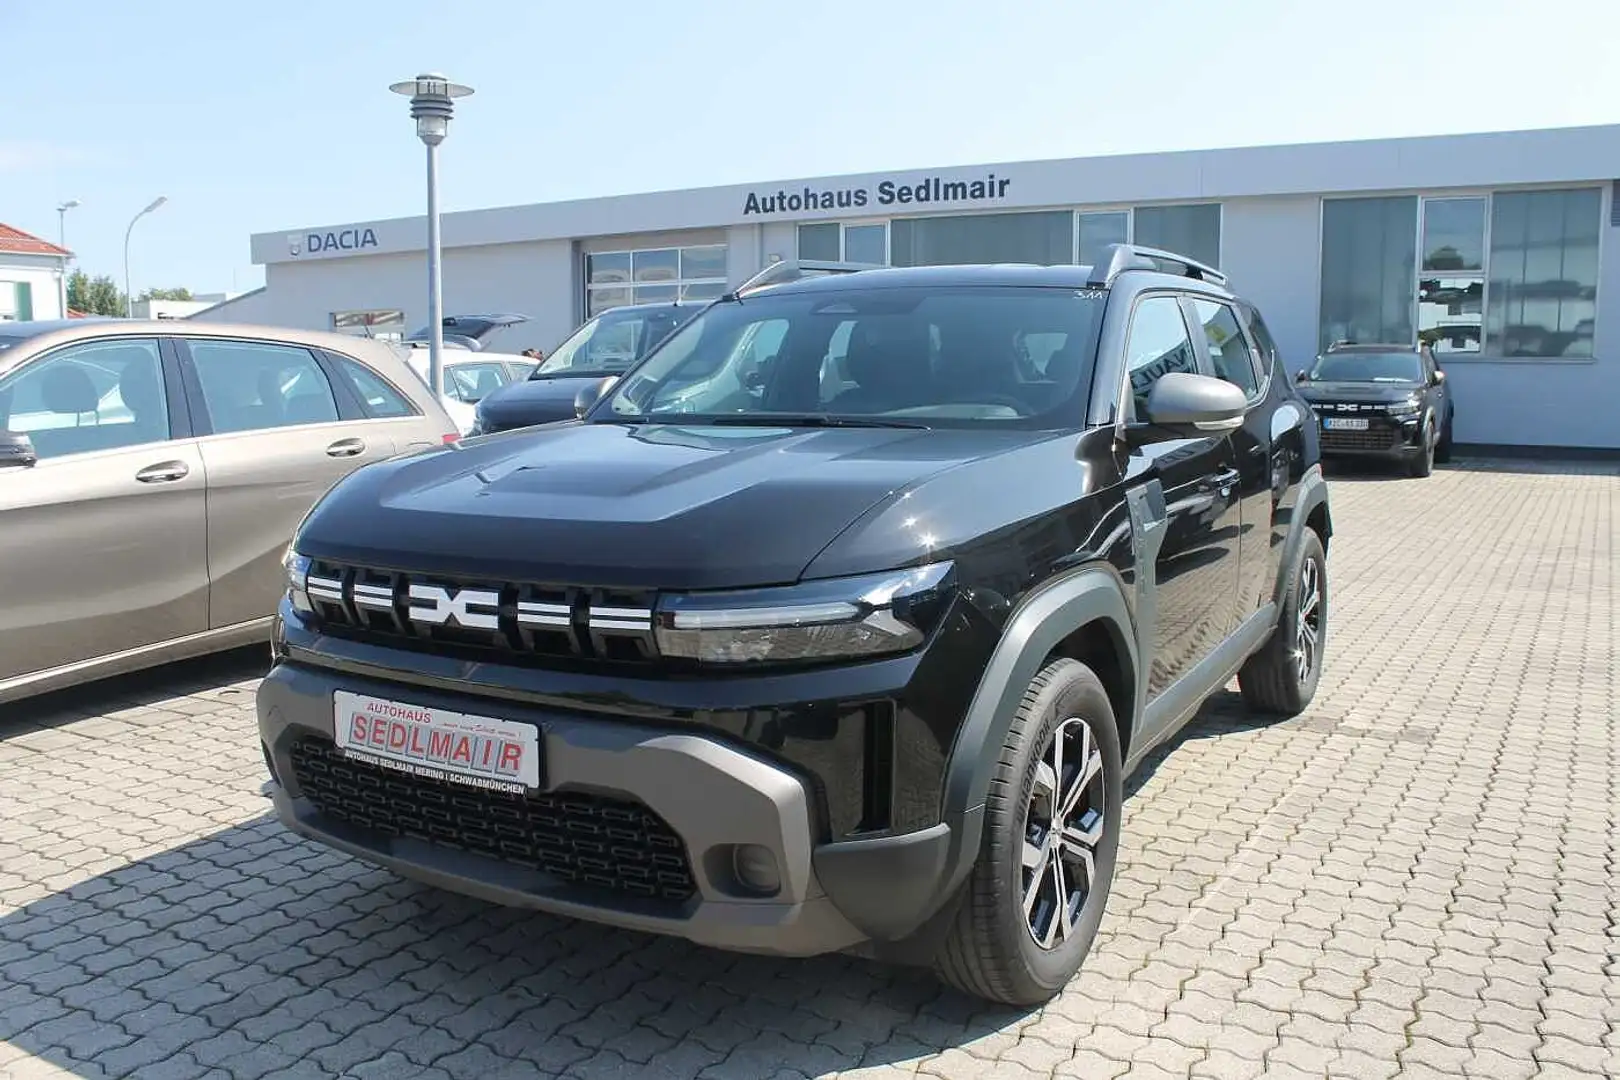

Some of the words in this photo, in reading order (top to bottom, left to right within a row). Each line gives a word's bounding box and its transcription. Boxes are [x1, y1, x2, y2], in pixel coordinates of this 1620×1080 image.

[743, 188, 868, 215] Autohaus
[878, 174, 1011, 205] Sedlmair
[307, 228, 379, 253] DACIA
[367, 702, 432, 724] AUTOHAUS
[353, 715, 525, 771] SEDLMAIR
[344, 751, 379, 765] AUTOHAUS
[379, 758, 414, 772] SEDLMAIR
[415, 765, 444, 780] MERING
[449, 773, 525, 795] SCHWABMÜNCHEN
